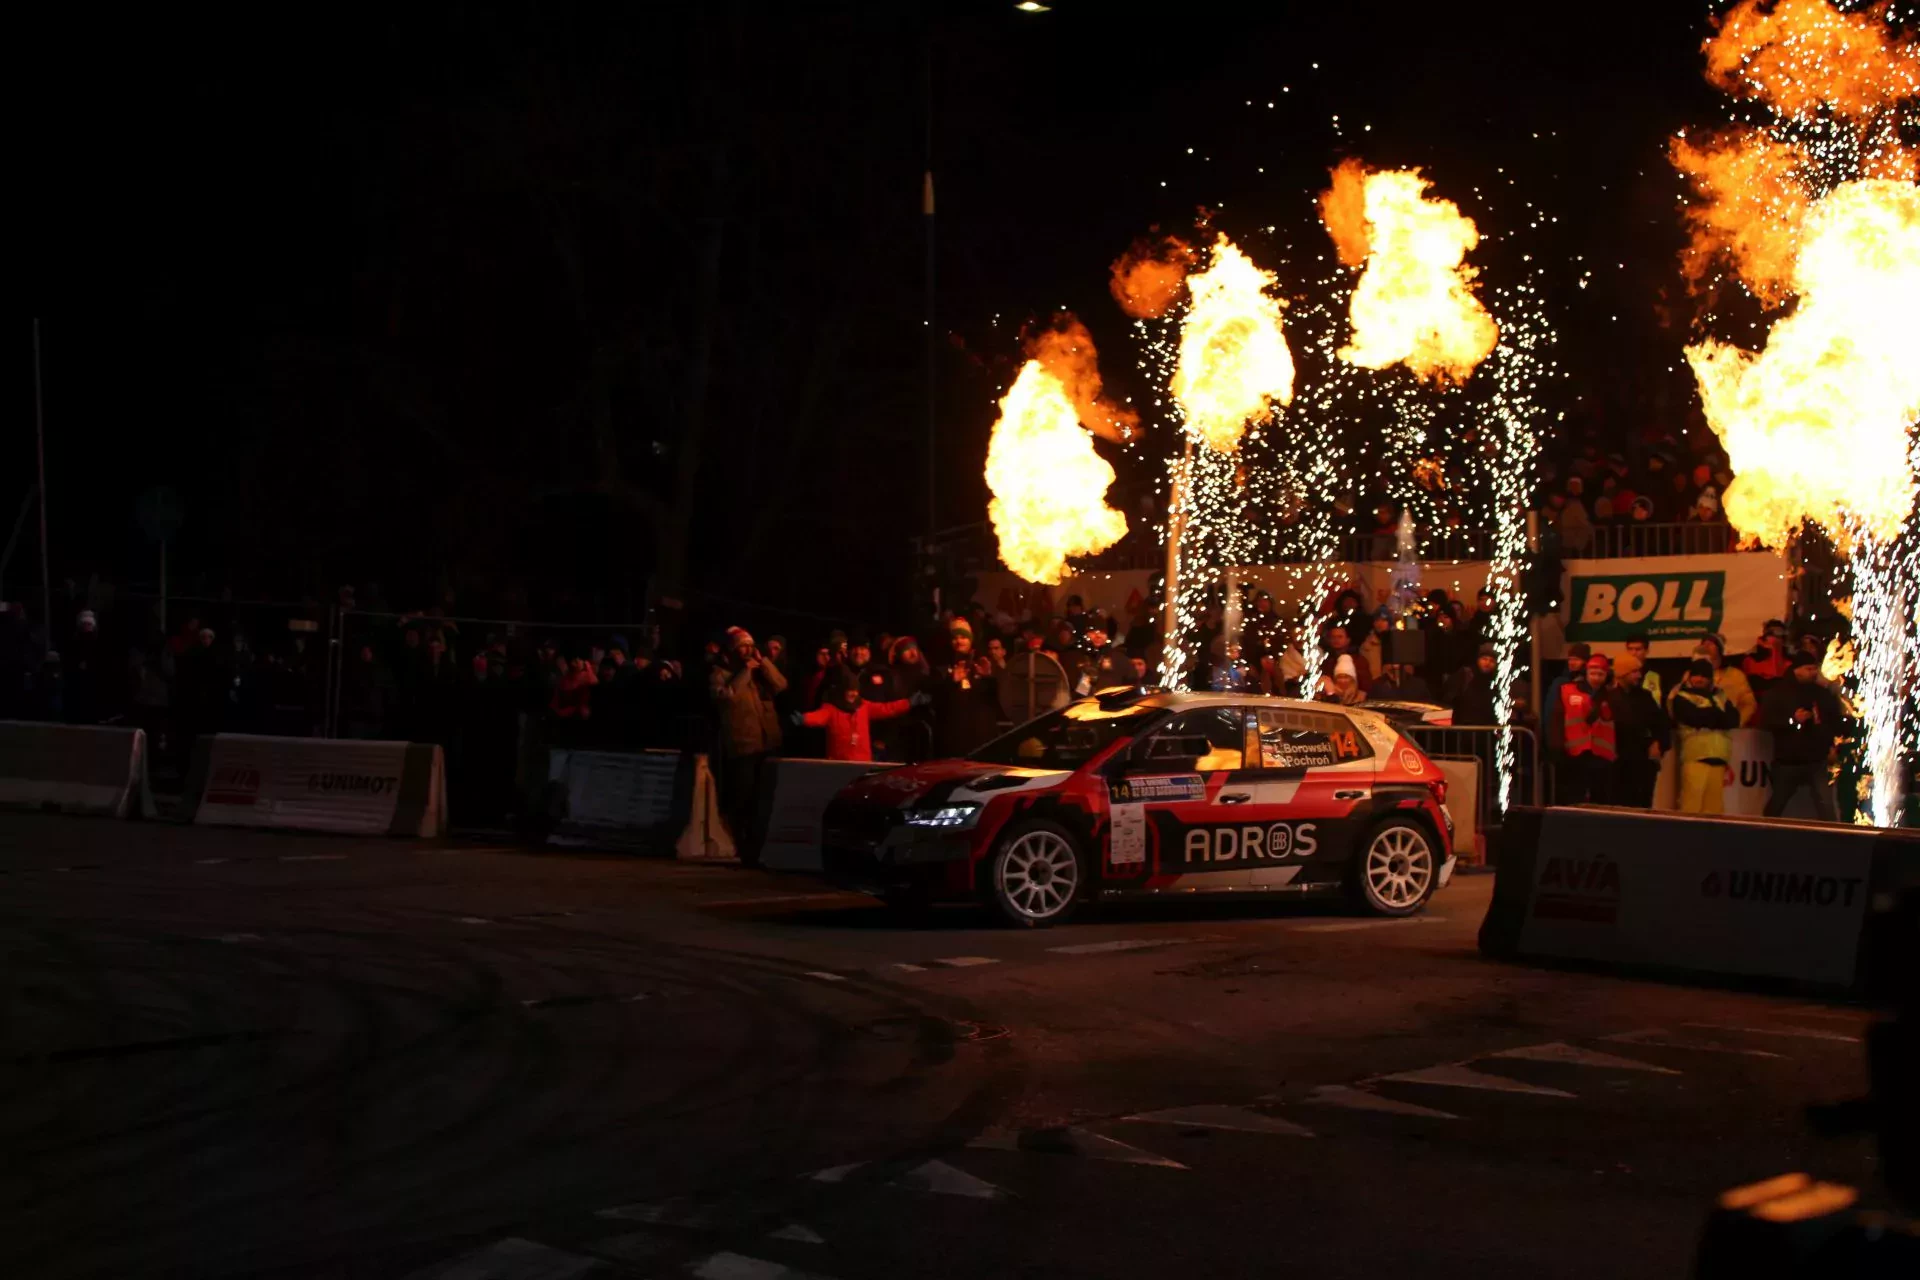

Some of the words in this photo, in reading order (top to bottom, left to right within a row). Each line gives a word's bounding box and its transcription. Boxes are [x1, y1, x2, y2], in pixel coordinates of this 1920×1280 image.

[1579, 580, 1712, 624] BOLL
[1283, 741, 1333, 753] Borowski
[1330, 731, 1360, 758] 14
[1286, 755, 1330, 766] Pochroń
[321, 774, 398, 794] UNIMOT
[1110, 783, 1130, 799] 14
[1184, 822, 1318, 863] ADROS
[1727, 870, 1863, 907] UNIMOT
